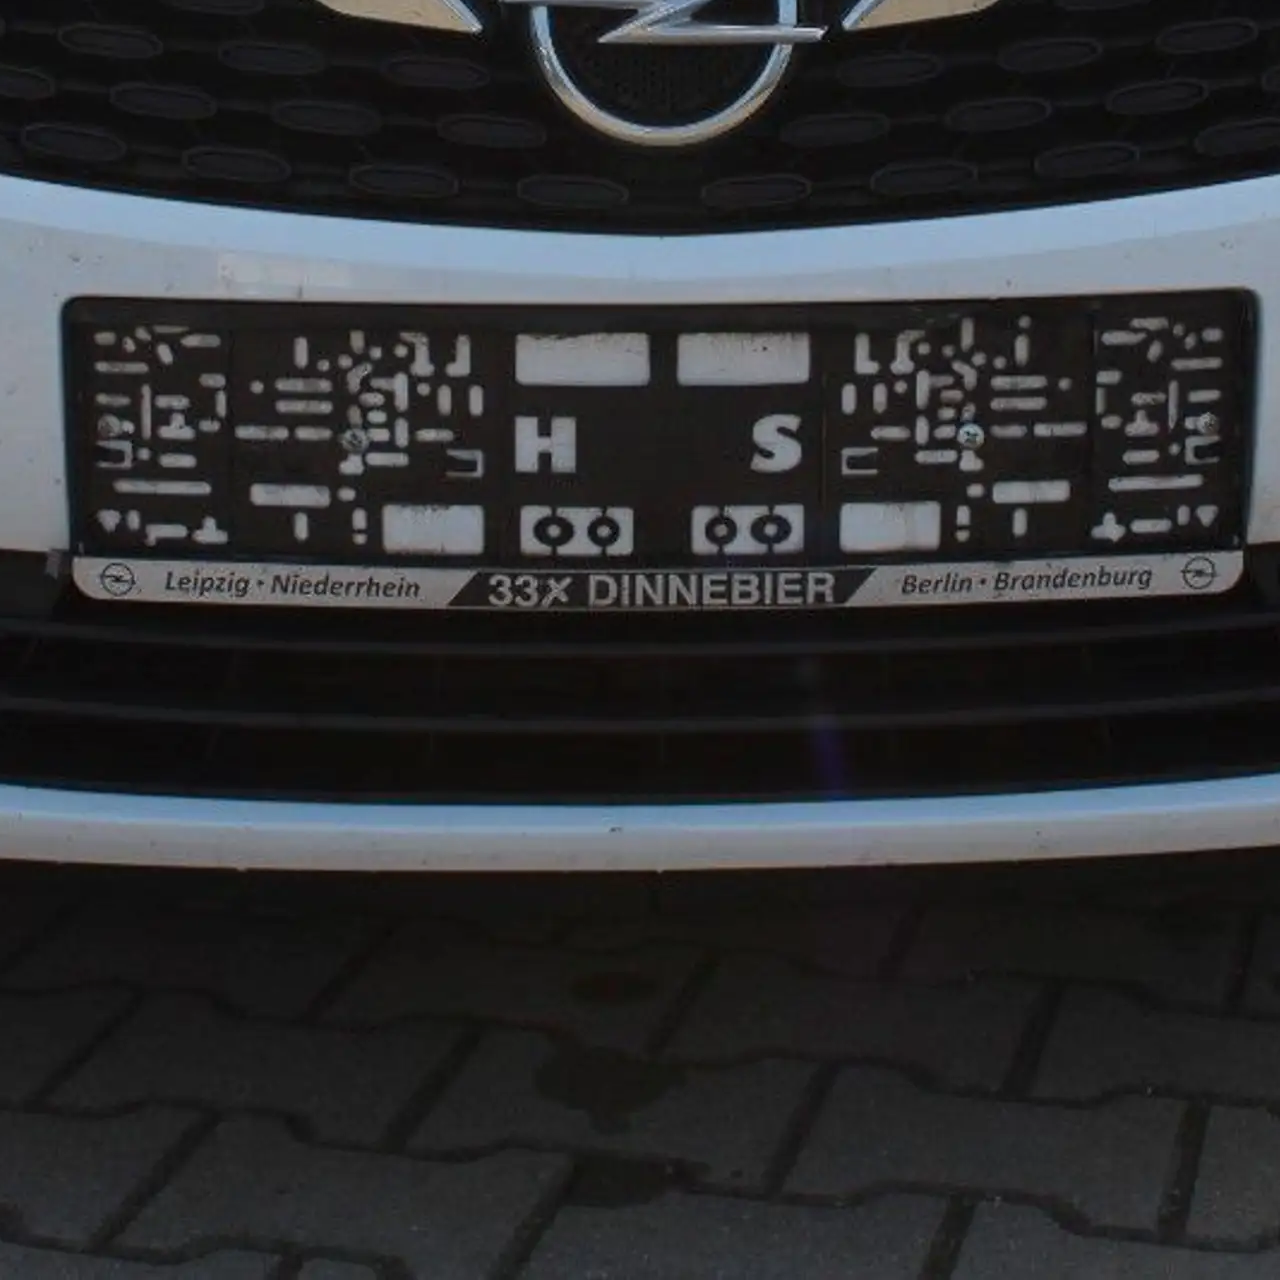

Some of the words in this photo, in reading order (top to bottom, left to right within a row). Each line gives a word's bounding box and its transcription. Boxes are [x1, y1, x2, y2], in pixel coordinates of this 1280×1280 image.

[515, 416, 576, 473] H
[750, 413, 803, 473] S
[165, 571, 250, 598] Leipzig
[270, 574, 421, 599] Niederrhein
[588, 571, 836, 606] DINNEBIER
[901, 574, 973, 595] Berlin
[993, 566, 1153, 592] Brandenburg
